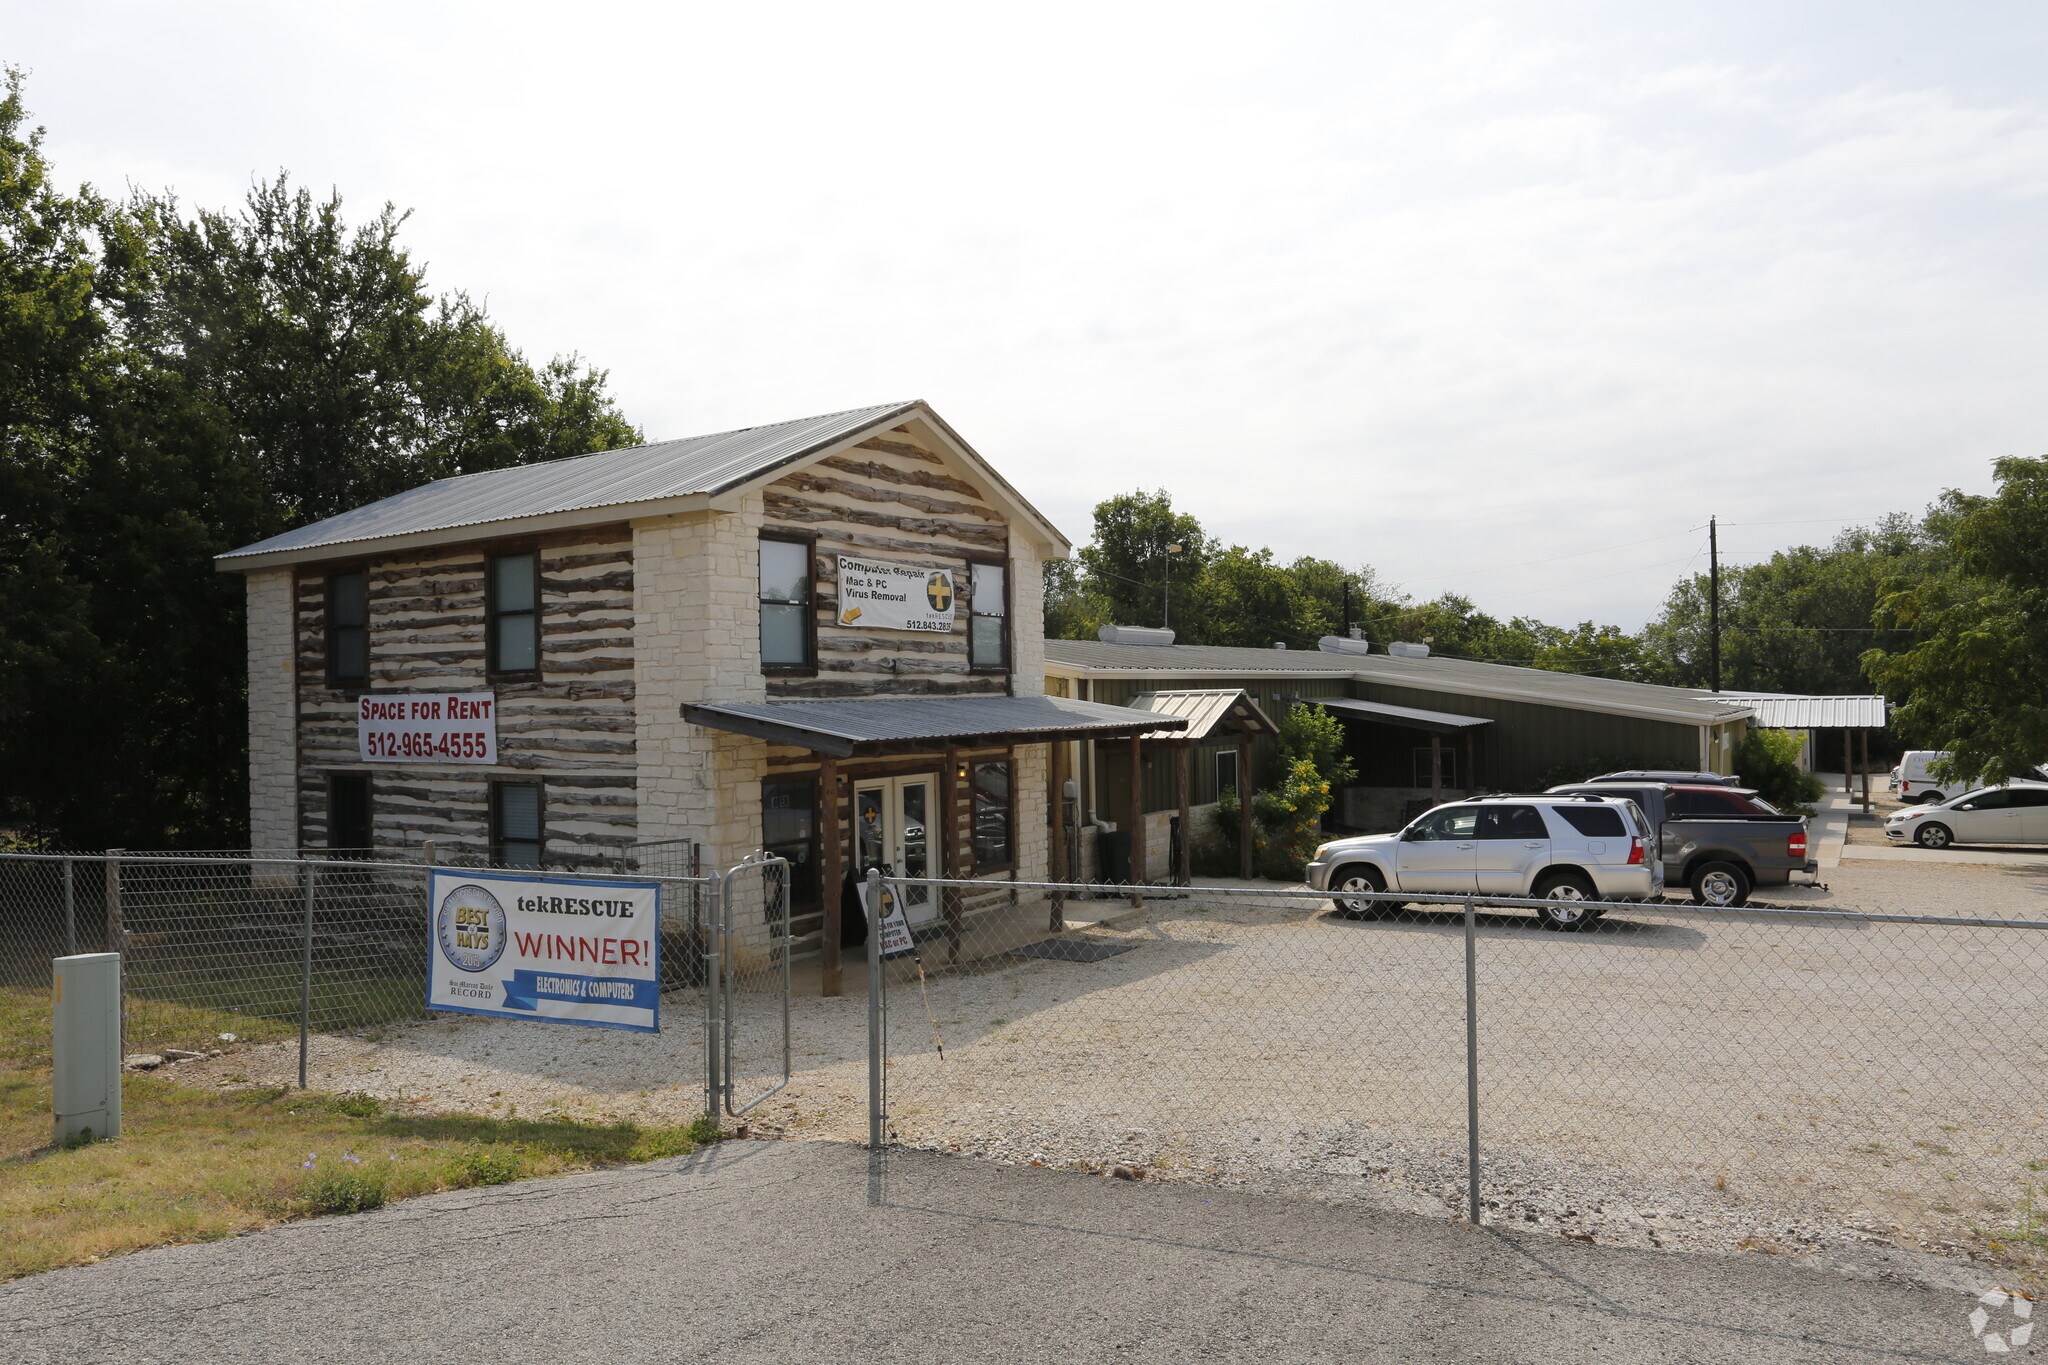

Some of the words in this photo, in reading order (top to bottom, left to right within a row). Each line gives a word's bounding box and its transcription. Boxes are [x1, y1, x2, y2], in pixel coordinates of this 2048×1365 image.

[839, 557, 892, 575] Computer
[892, 567, 925, 580] Repair
[845, 576, 864, 587] Mac
[866, 578, 873, 587] &
[875, 579, 887, 589] PC
[845, 587, 869, 599] Virus
[871, 590, 907, 602] Removal
[368, 732, 487, 758] 512-965-4555
[517, 895, 634, 918] tekRESCUE
[456, 907, 489, 926] BEST
[456, 931, 489, 950] HAYS
[514, 931, 649, 967] WINNER!
[462, 953, 480, 967] 2015
[450, 987, 492, 999] RECORD
[536, 976, 580, 996] ELECTRONICS
[580, 980, 587, 997] &
[588, 981, 634, 1000] COMPUTERS
